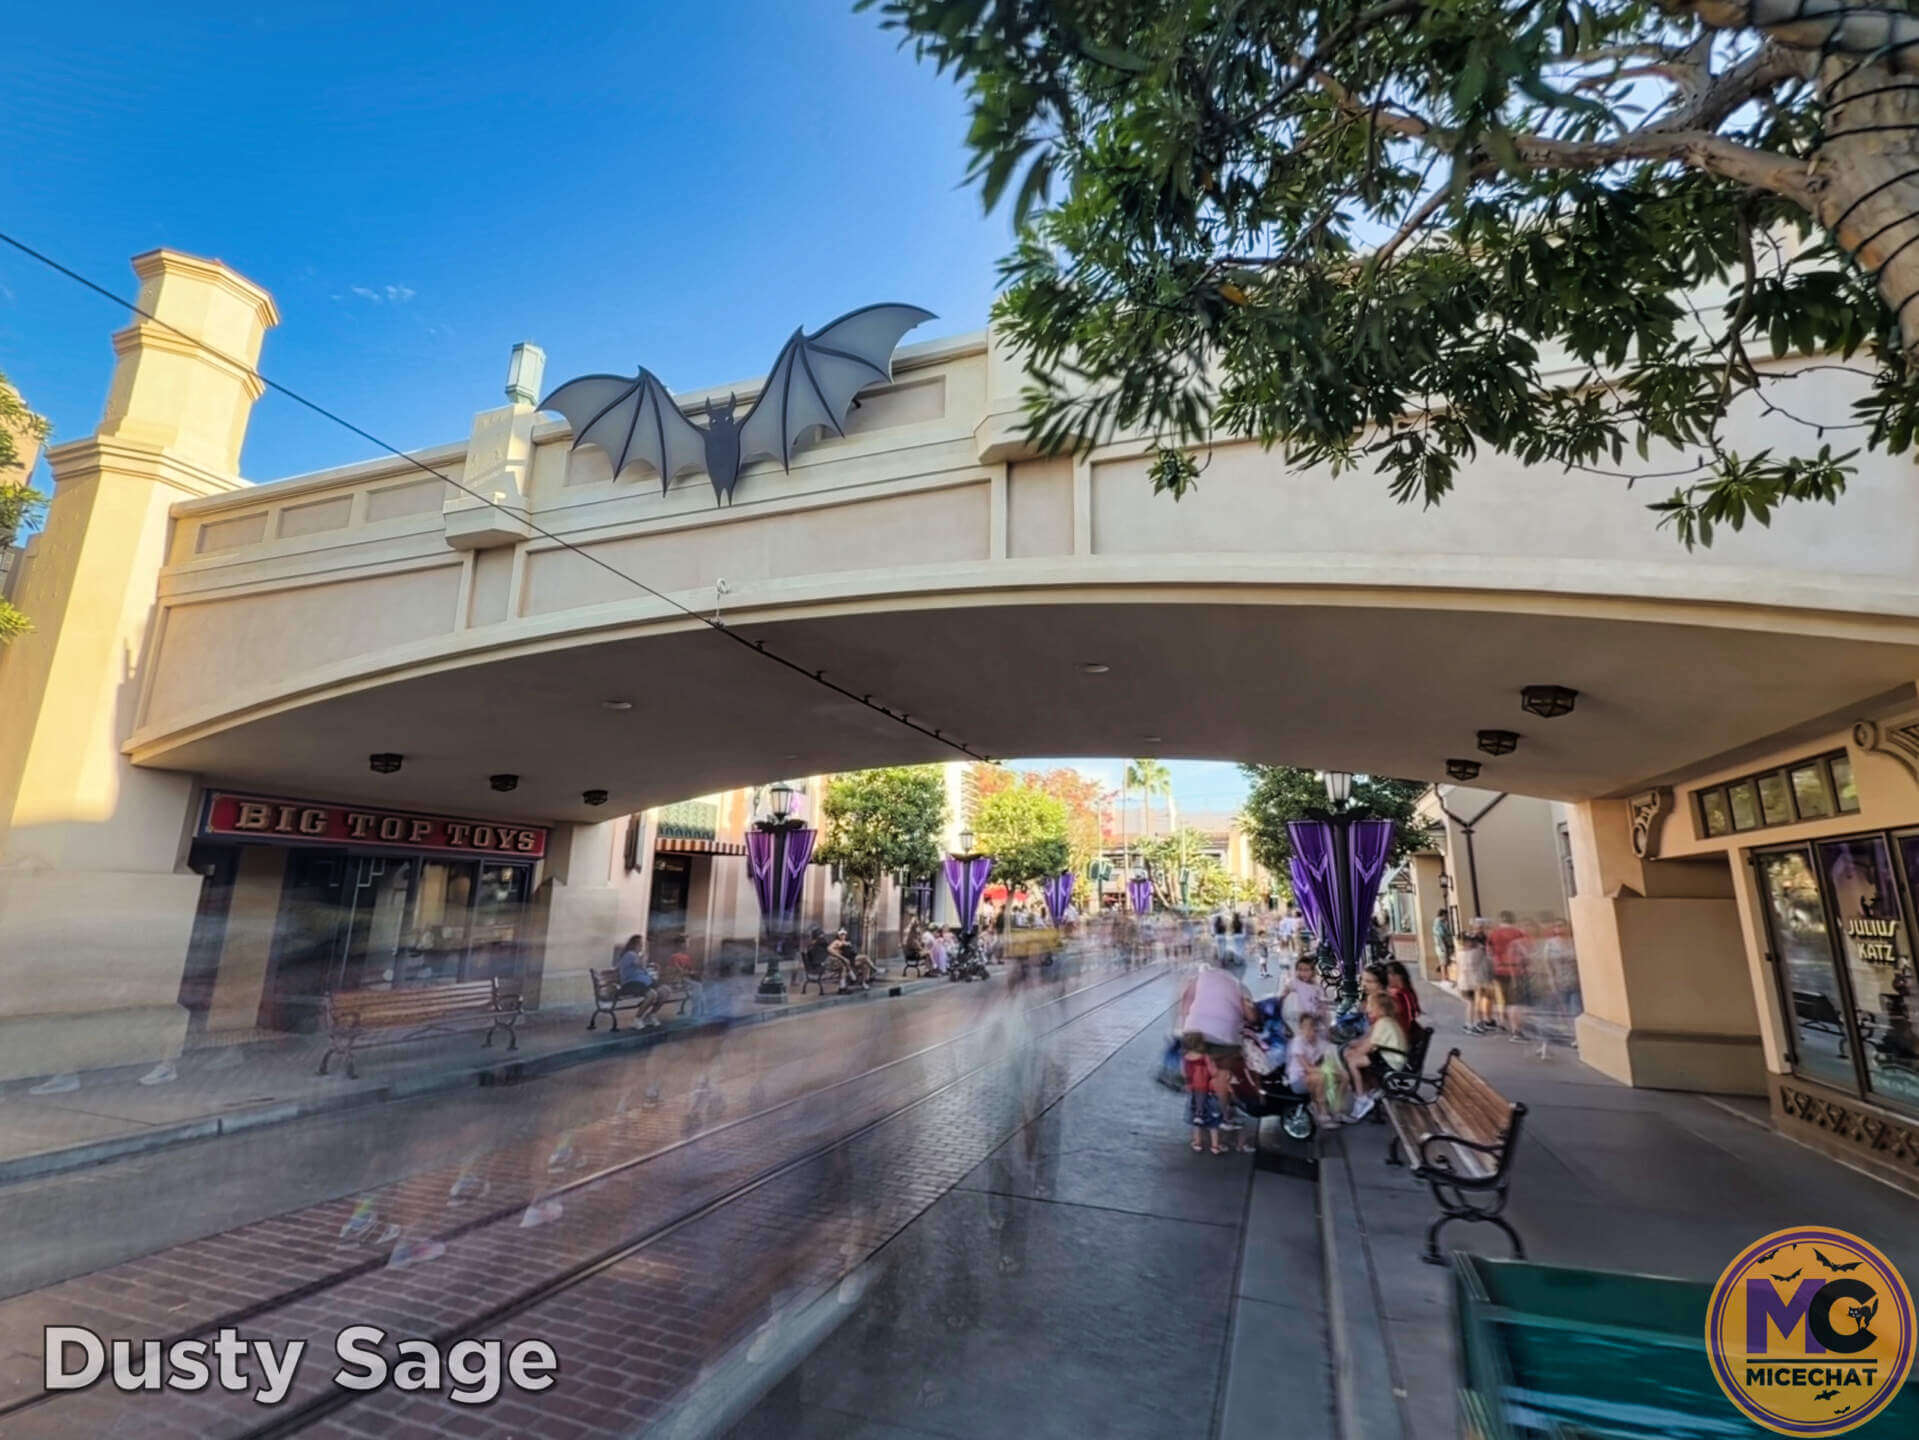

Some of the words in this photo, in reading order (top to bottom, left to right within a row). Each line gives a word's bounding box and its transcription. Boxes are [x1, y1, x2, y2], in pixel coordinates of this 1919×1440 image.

[234, 802, 329, 834] BIG
[347, 813, 434, 841] TOP
[447, 823, 536, 851] TOYS
[1847, 919, 1897, 937] JULIUS
[1857, 943, 1896, 962] KATZ
